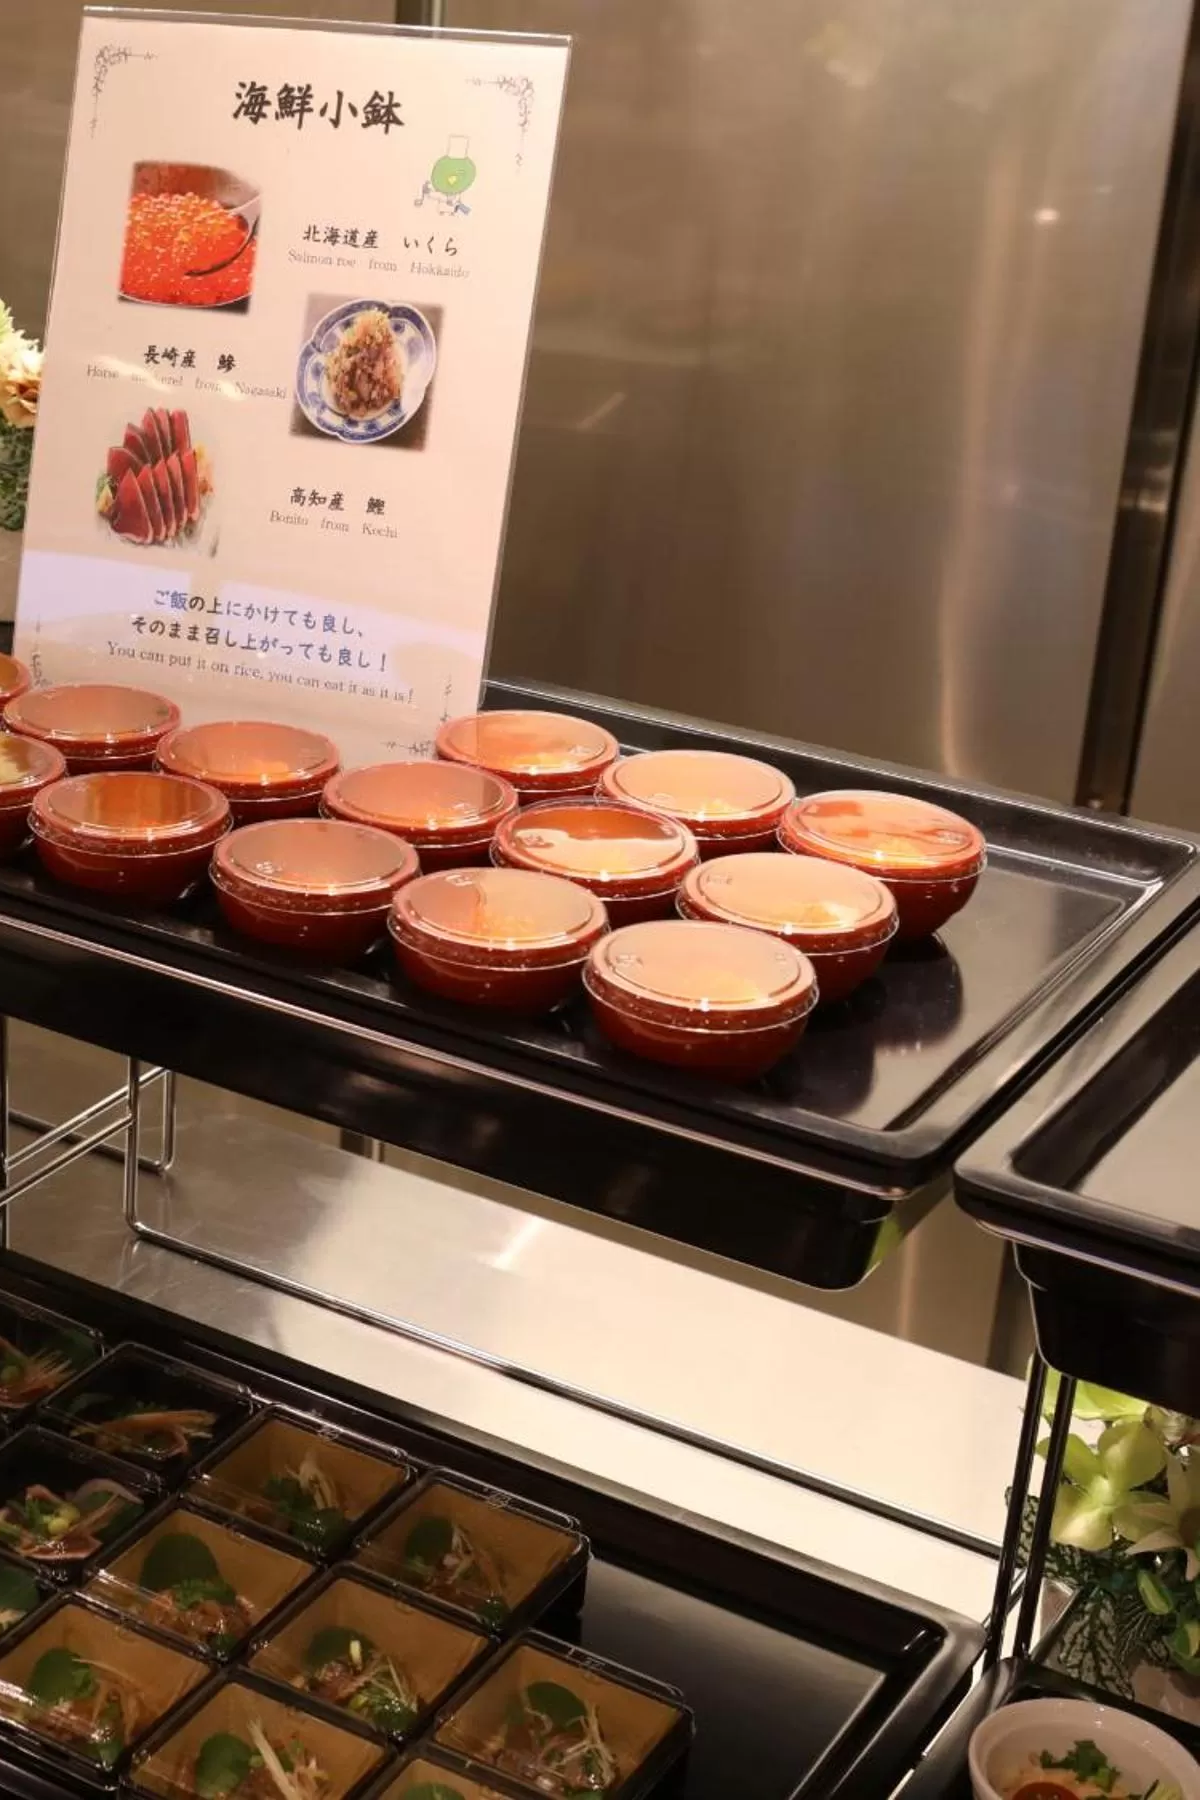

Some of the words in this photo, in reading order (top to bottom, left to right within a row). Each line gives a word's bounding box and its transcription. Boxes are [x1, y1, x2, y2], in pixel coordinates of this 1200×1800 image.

[232, 80, 405, 135] 海鮮小鉢
[302, 223, 379, 249] 北海道産
[403, 235, 458, 257] いくら
[287, 249, 333, 267] Salmon
[368, 258, 398, 272] from
[410, 261, 471, 280] Hokkaido
[143, 344, 197, 369] 長崎産
[131, 370, 184, 388] maerel
[235, 380, 287, 400] Nagasaki
[289, 485, 345, 512] 高知産
[269, 509, 309, 527] Bonito
[320, 517, 350, 533] from
[361, 522, 399, 539] Kochi
[154, 589, 364, 638] ご飯の上にかけても良し、
[107, 640, 136, 659] You
[140, 650, 164, 664] can
[168, 653, 192, 669] put
[196, 657, 207, 671] it
[210, 662, 230, 675] on
[233, 661, 264, 680] rice,
[267, 669, 294, 685] you
[296, 674, 320, 689] can
[324, 679, 344, 693] eat
[348, 682, 358, 695] it
[362, 685, 376, 697] as
[379, 687, 389, 700] it
